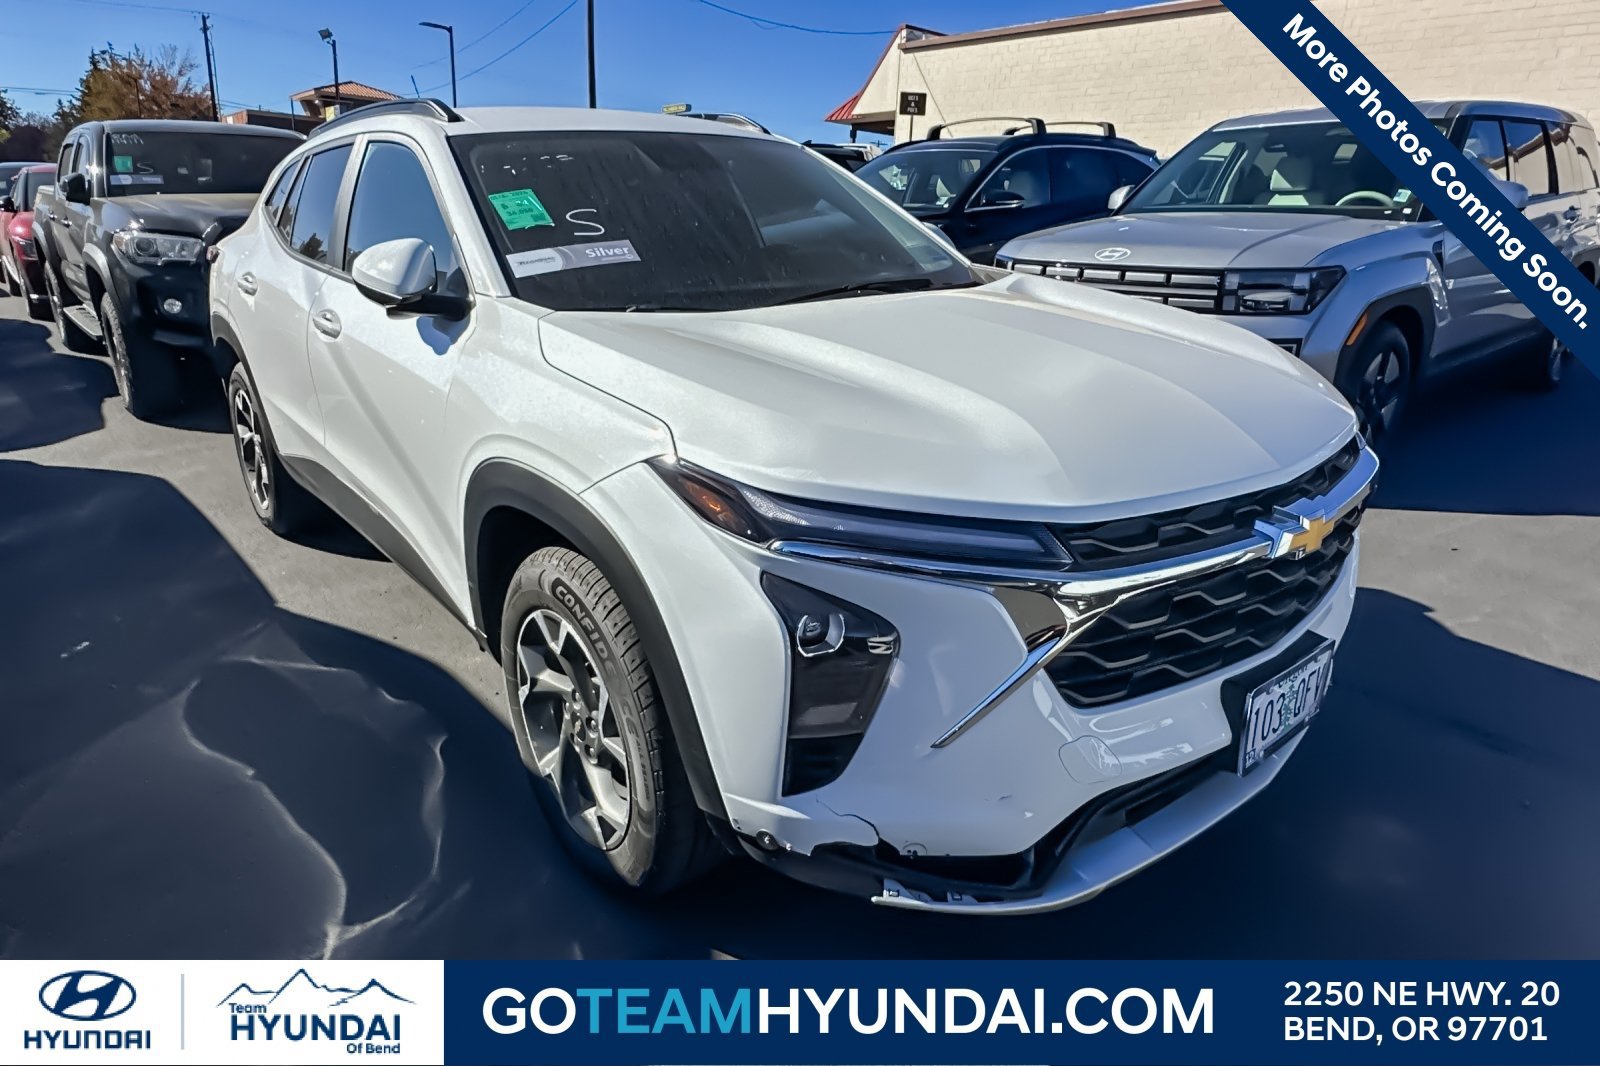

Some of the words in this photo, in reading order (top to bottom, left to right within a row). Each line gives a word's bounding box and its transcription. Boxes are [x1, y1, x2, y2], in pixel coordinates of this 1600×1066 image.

[565, 208, 606, 236] S
[585, 245, 631, 259] Silver
[1251, 692, 1286, 748] 103
